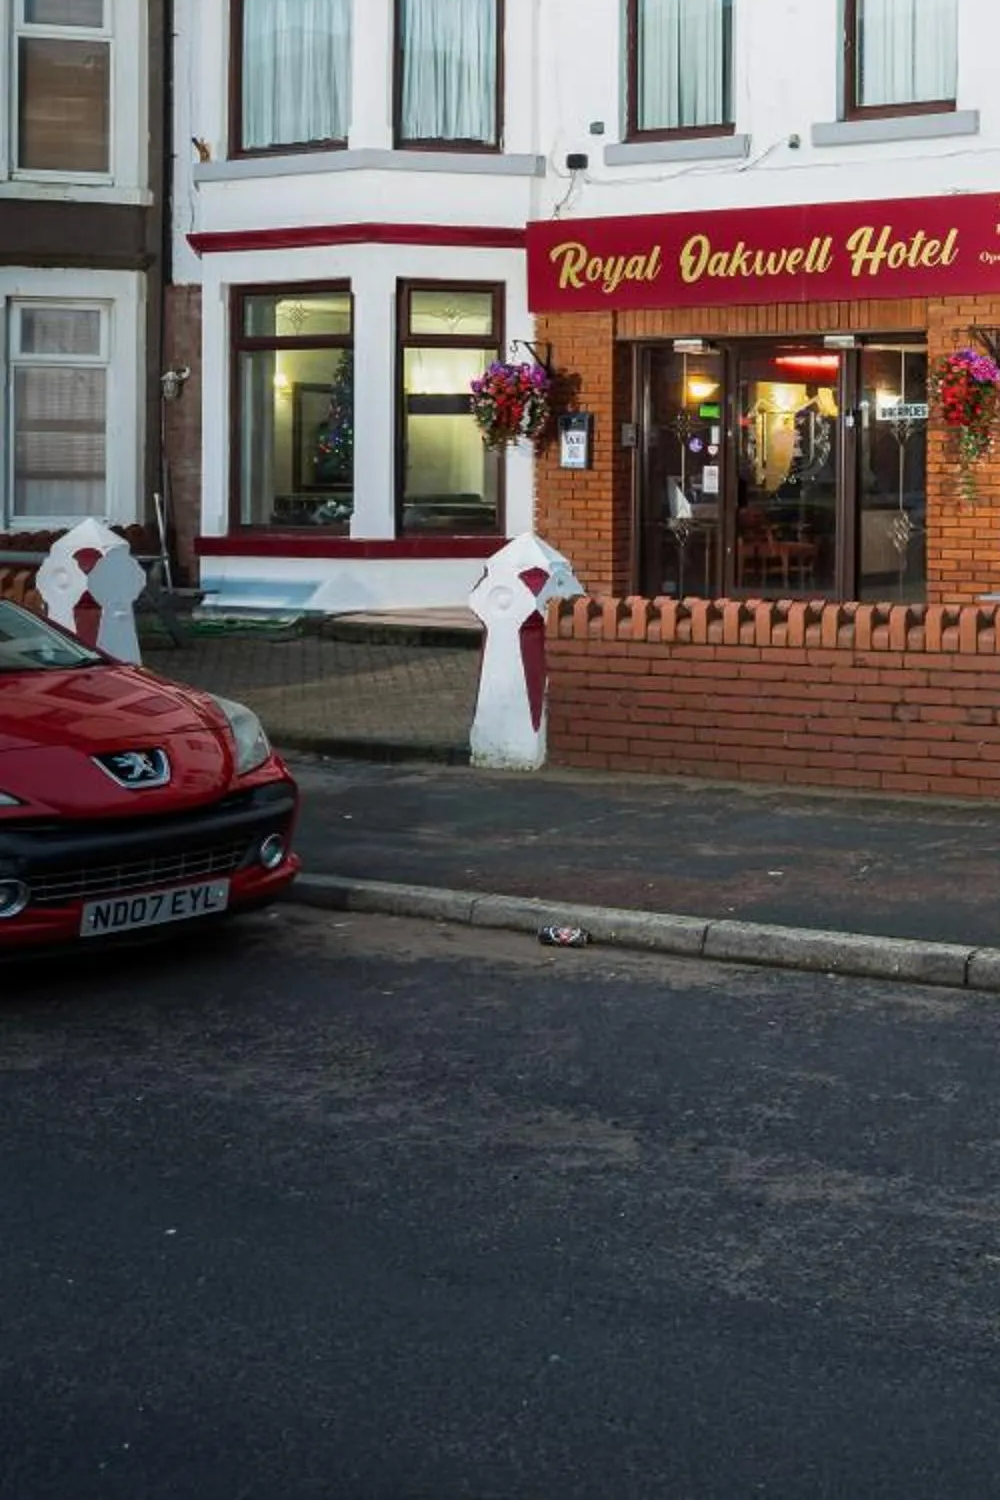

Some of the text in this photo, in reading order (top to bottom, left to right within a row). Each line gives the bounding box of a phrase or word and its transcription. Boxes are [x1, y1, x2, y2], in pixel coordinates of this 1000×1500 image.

[549, 225, 960, 294] Royal Oakwell Hotel
[92, 885, 217, 930] ND07 EYL
